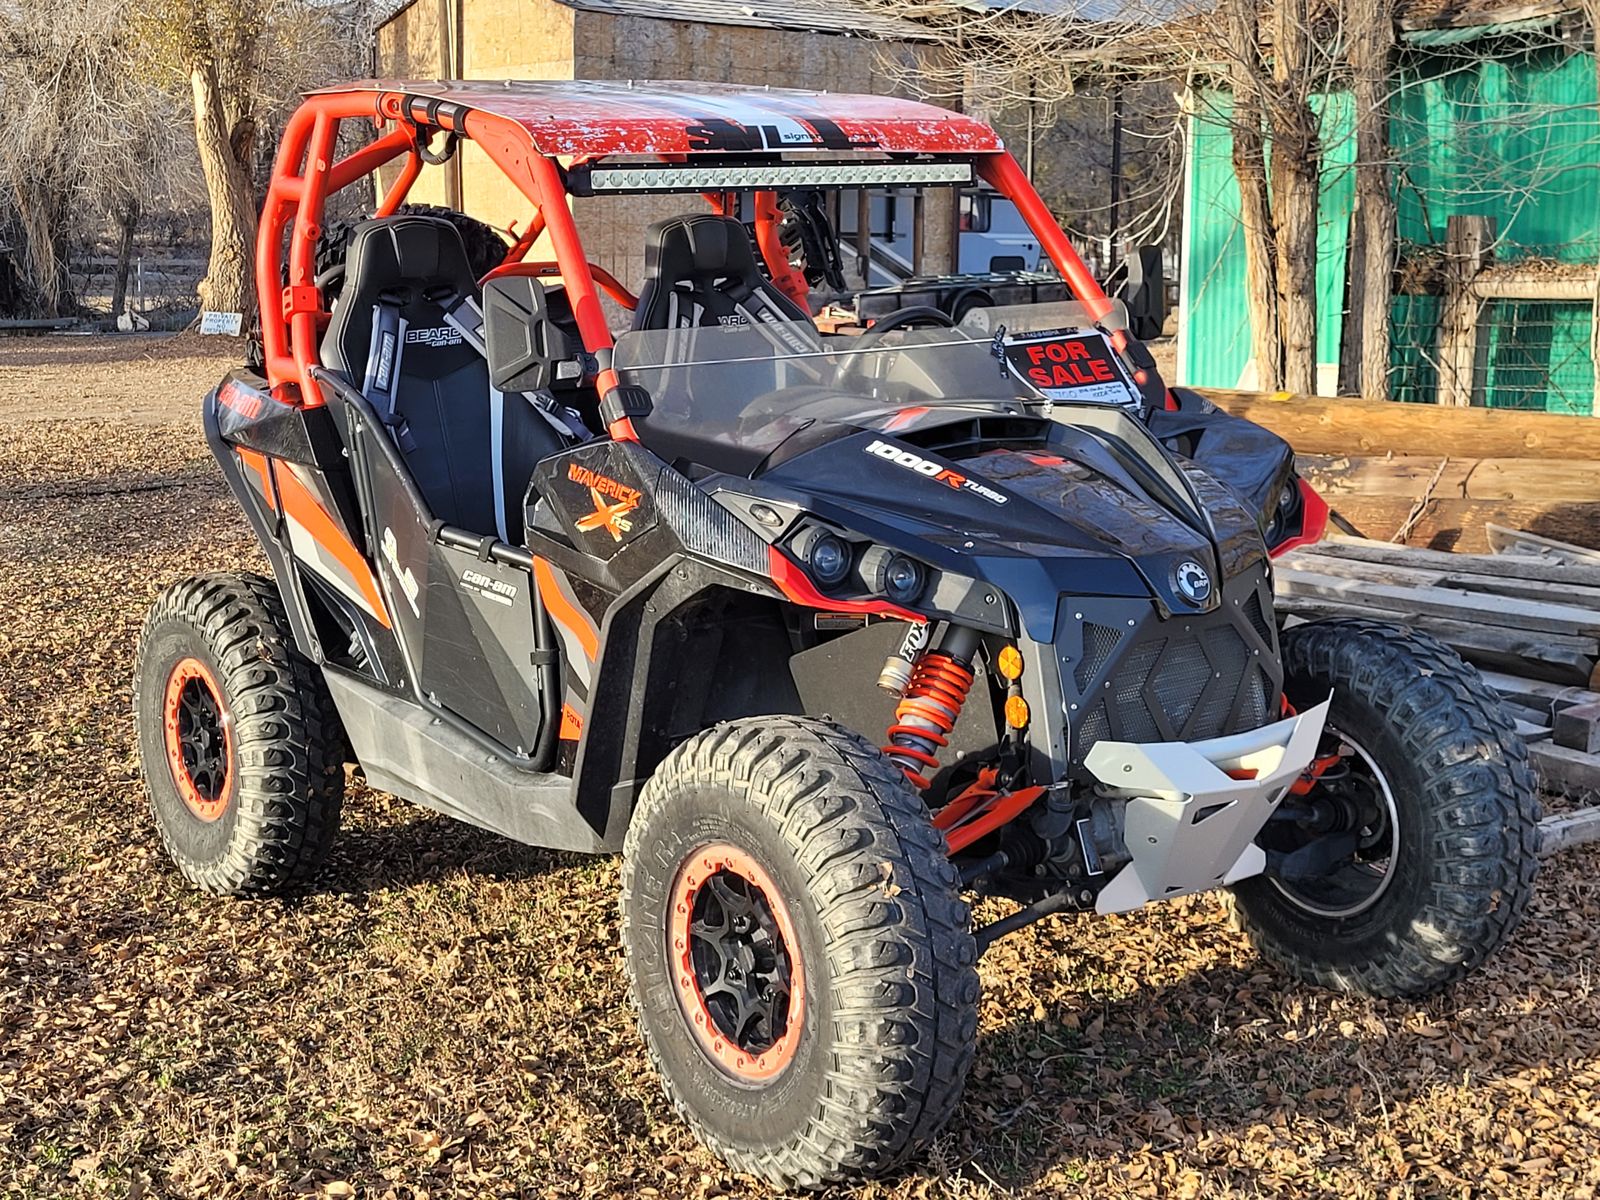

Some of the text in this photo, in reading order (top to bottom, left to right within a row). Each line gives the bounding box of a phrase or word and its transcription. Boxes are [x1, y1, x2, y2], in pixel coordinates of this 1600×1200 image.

[405, 326, 462, 344] BEARD
[431, 337, 463, 347] can-am
[377, 334, 395, 390] can-am
[1026, 341, 1091, 365] FOR
[1028, 359, 1115, 388] SALE
[567, 463, 642, 509] MAVERICK
[963, 479, 1008, 504] TURBO
[462, 569, 518, 599] can-am
[900, 622, 924, 662] FOX
